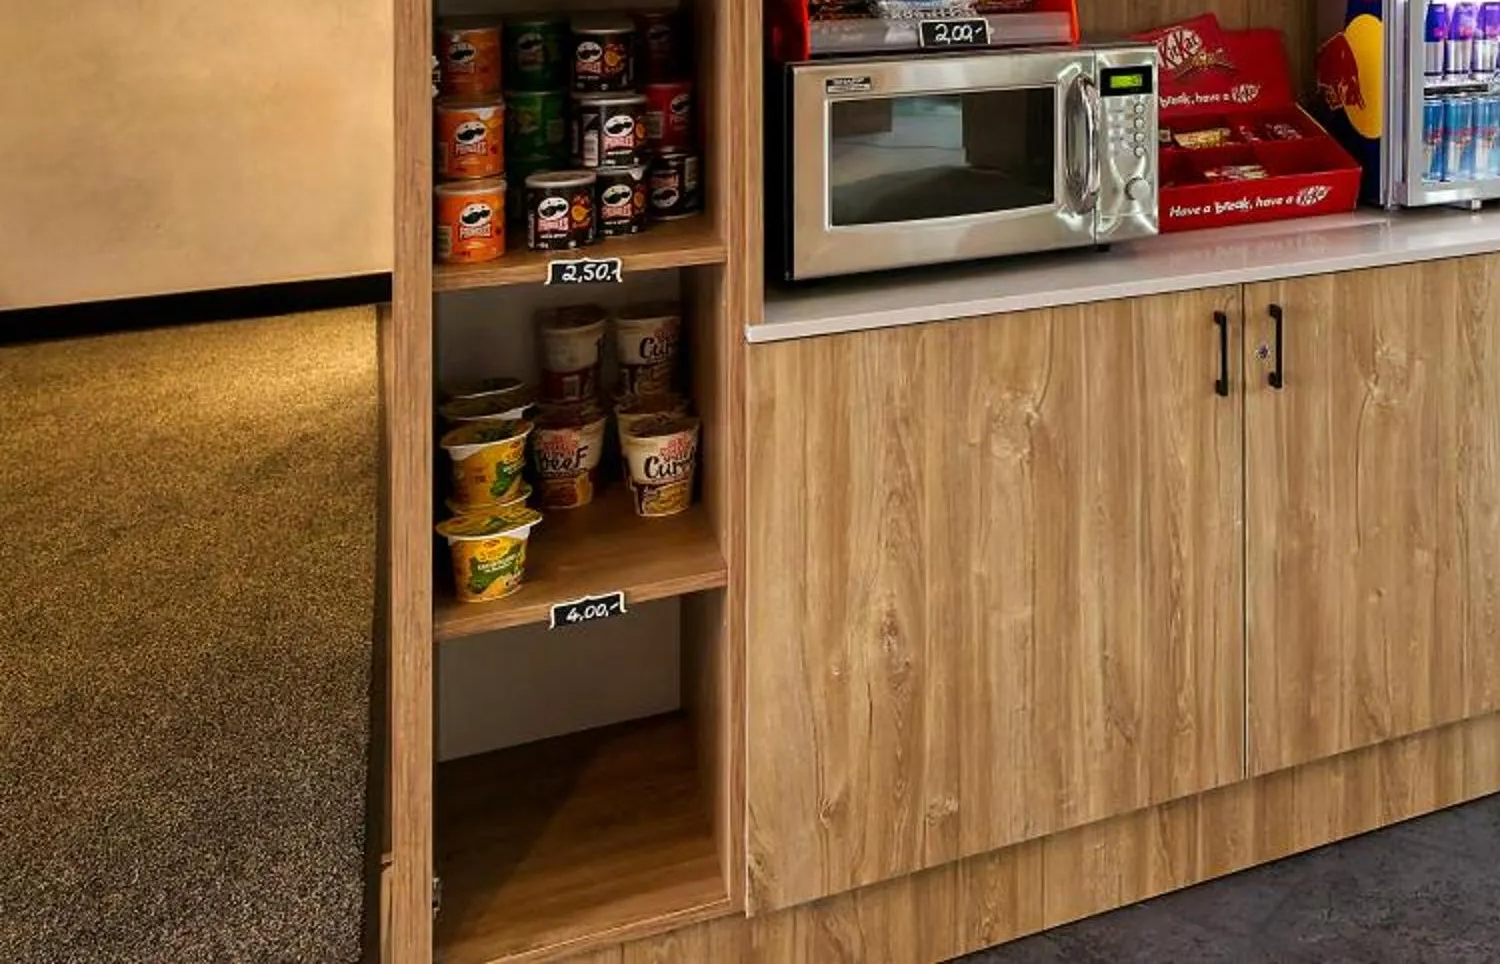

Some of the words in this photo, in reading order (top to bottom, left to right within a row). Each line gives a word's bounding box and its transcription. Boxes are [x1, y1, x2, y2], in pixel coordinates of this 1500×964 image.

[1169, 204, 1201, 218] Have
[1203, 206, 1211, 214] a
[1255, 195, 1283, 208] have
